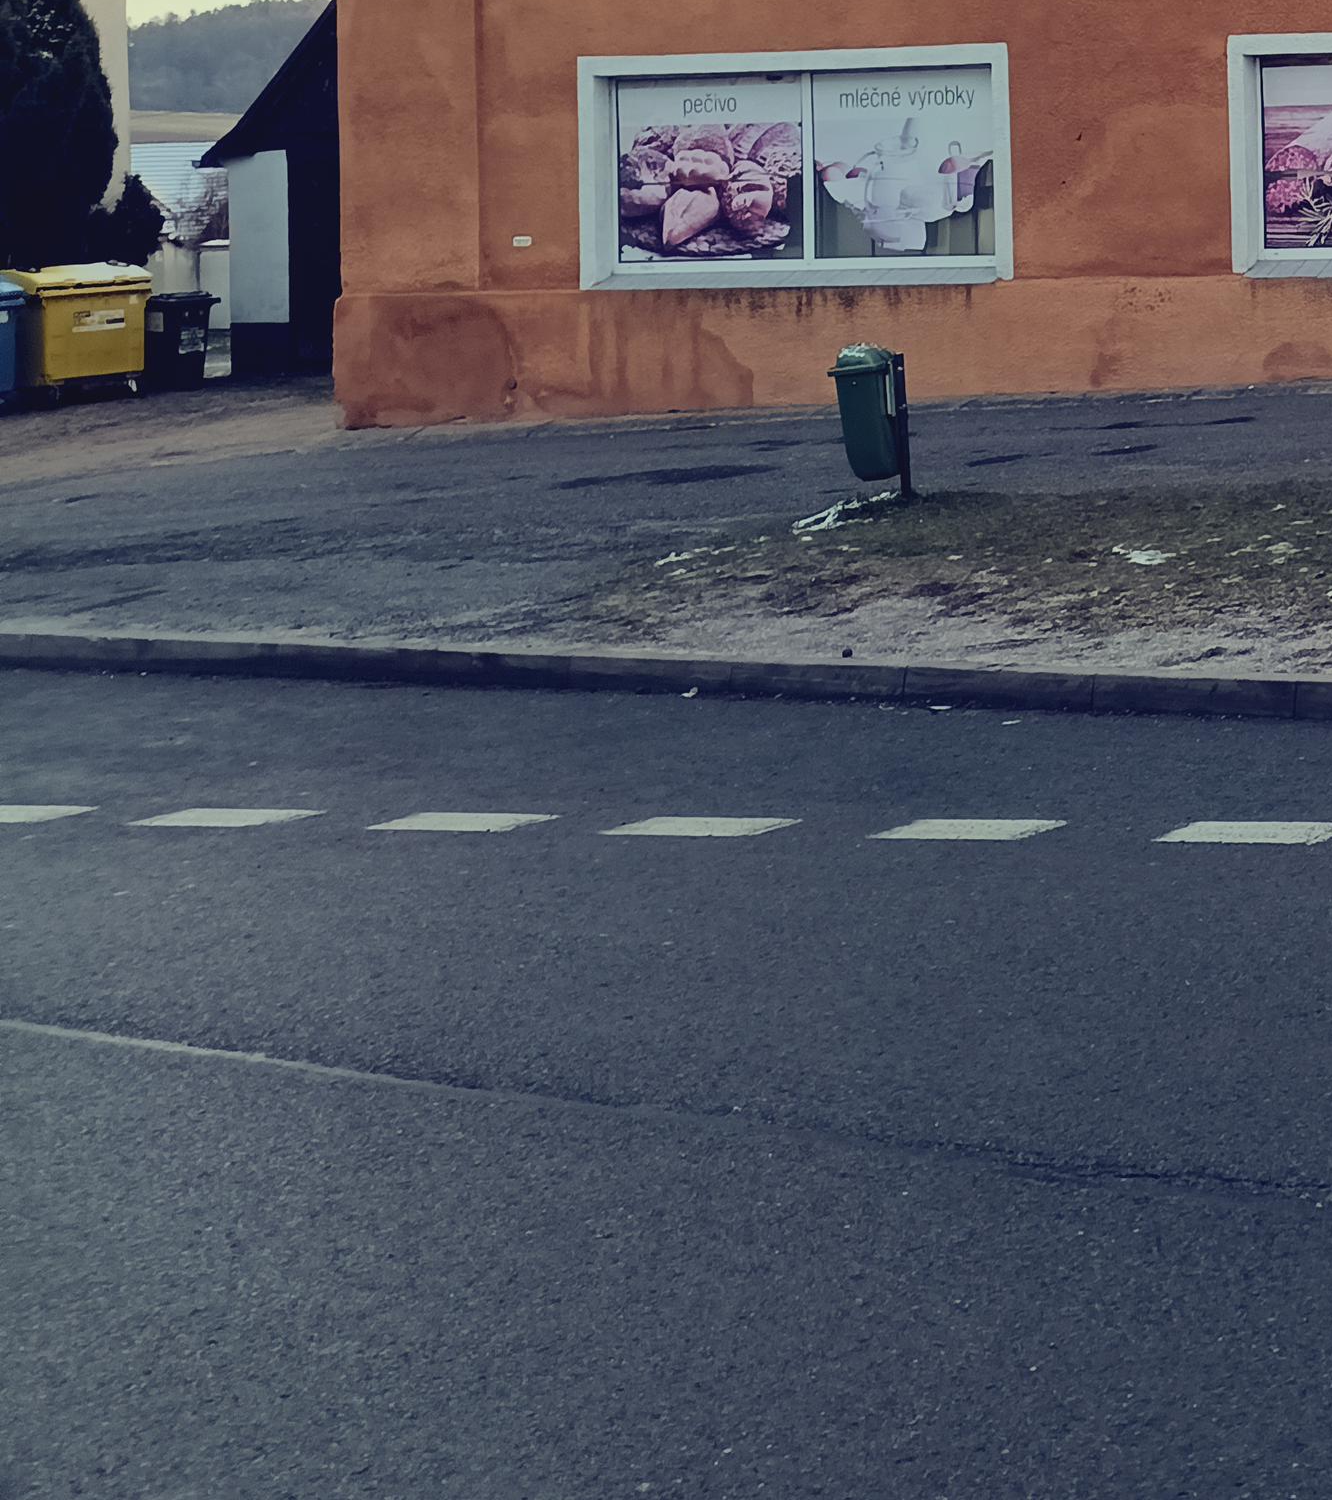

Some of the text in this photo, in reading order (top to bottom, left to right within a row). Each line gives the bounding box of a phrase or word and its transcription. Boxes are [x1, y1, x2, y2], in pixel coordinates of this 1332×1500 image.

[683, 94, 737, 117] pečivo
[839, 85, 975, 111] mléčné výrobky
